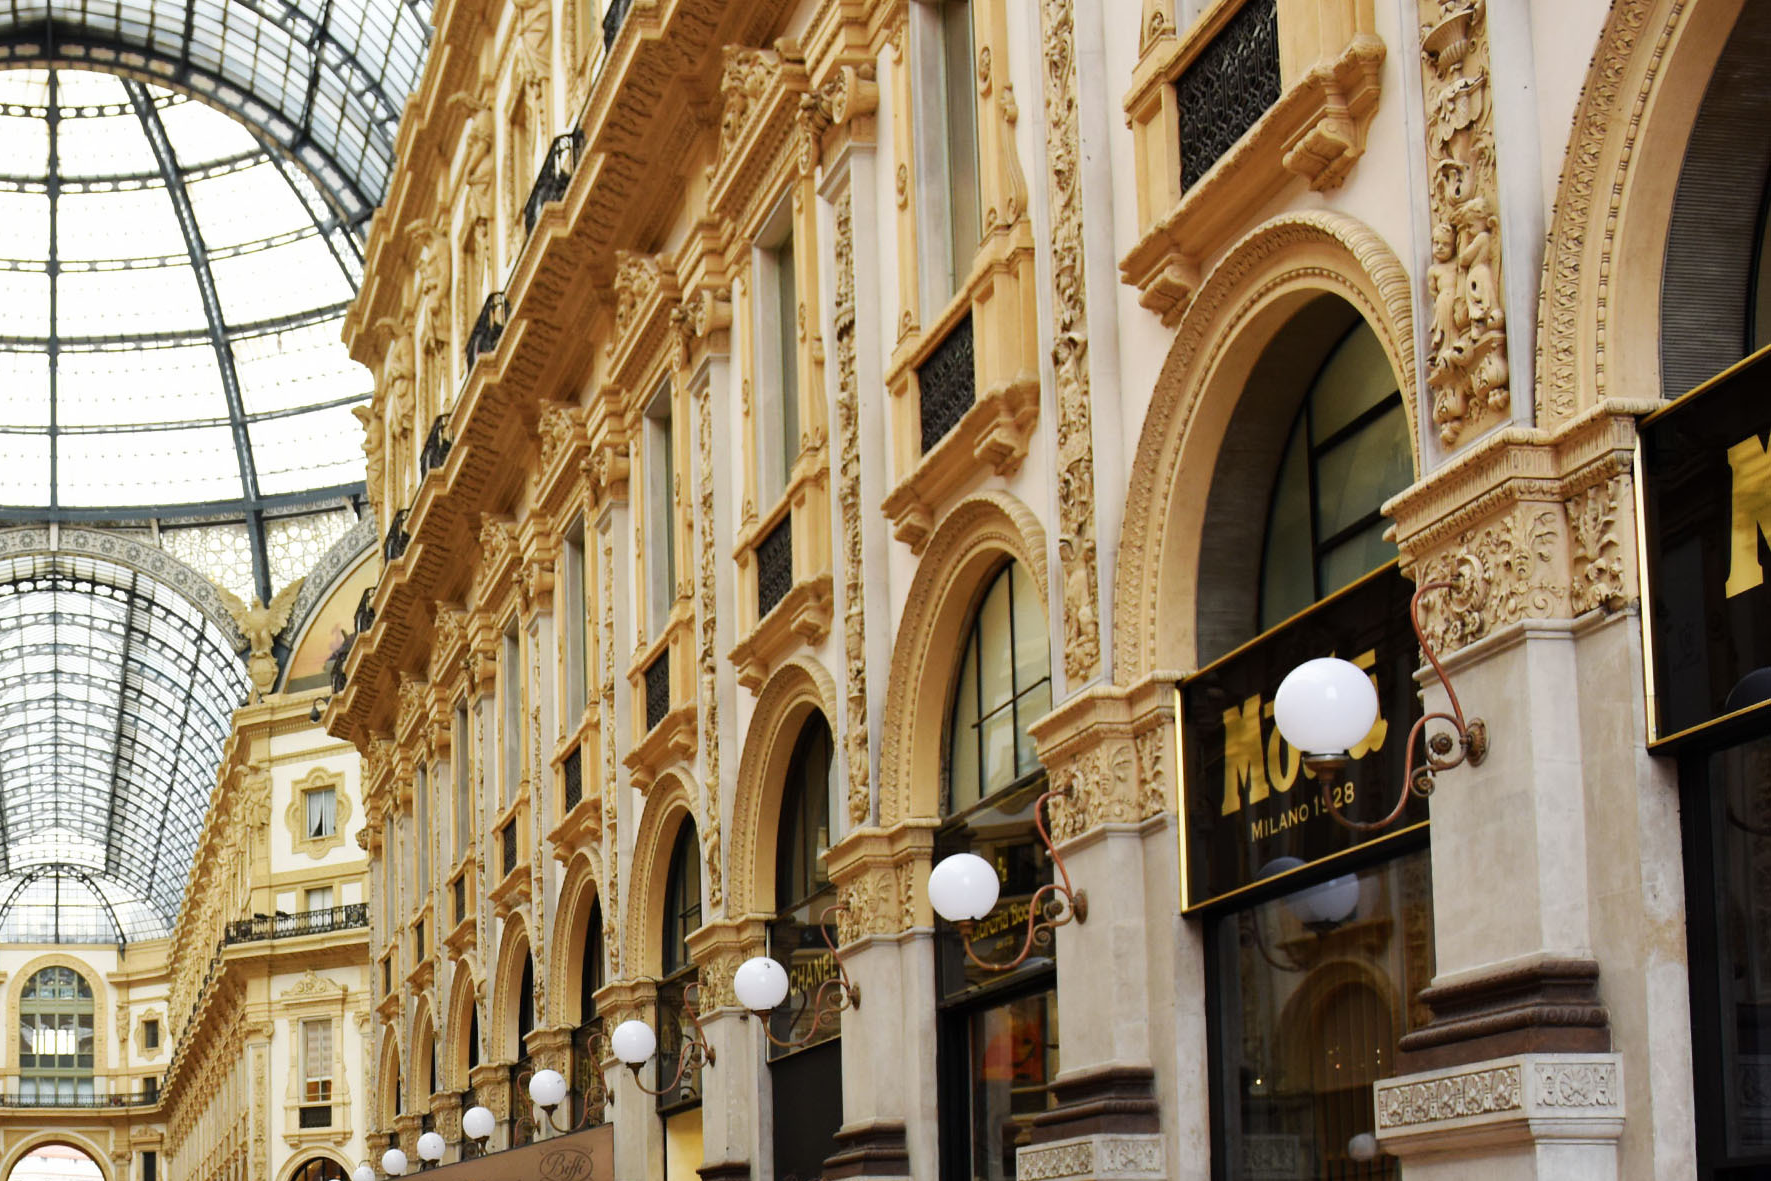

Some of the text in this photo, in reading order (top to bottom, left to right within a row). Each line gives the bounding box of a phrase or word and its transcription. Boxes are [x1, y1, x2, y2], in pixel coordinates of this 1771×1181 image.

[1251, 803, 1309, 843] MILANO
[790, 950, 838, 997] CHANEL
[545, 1152, 587, 1181] Biffi
